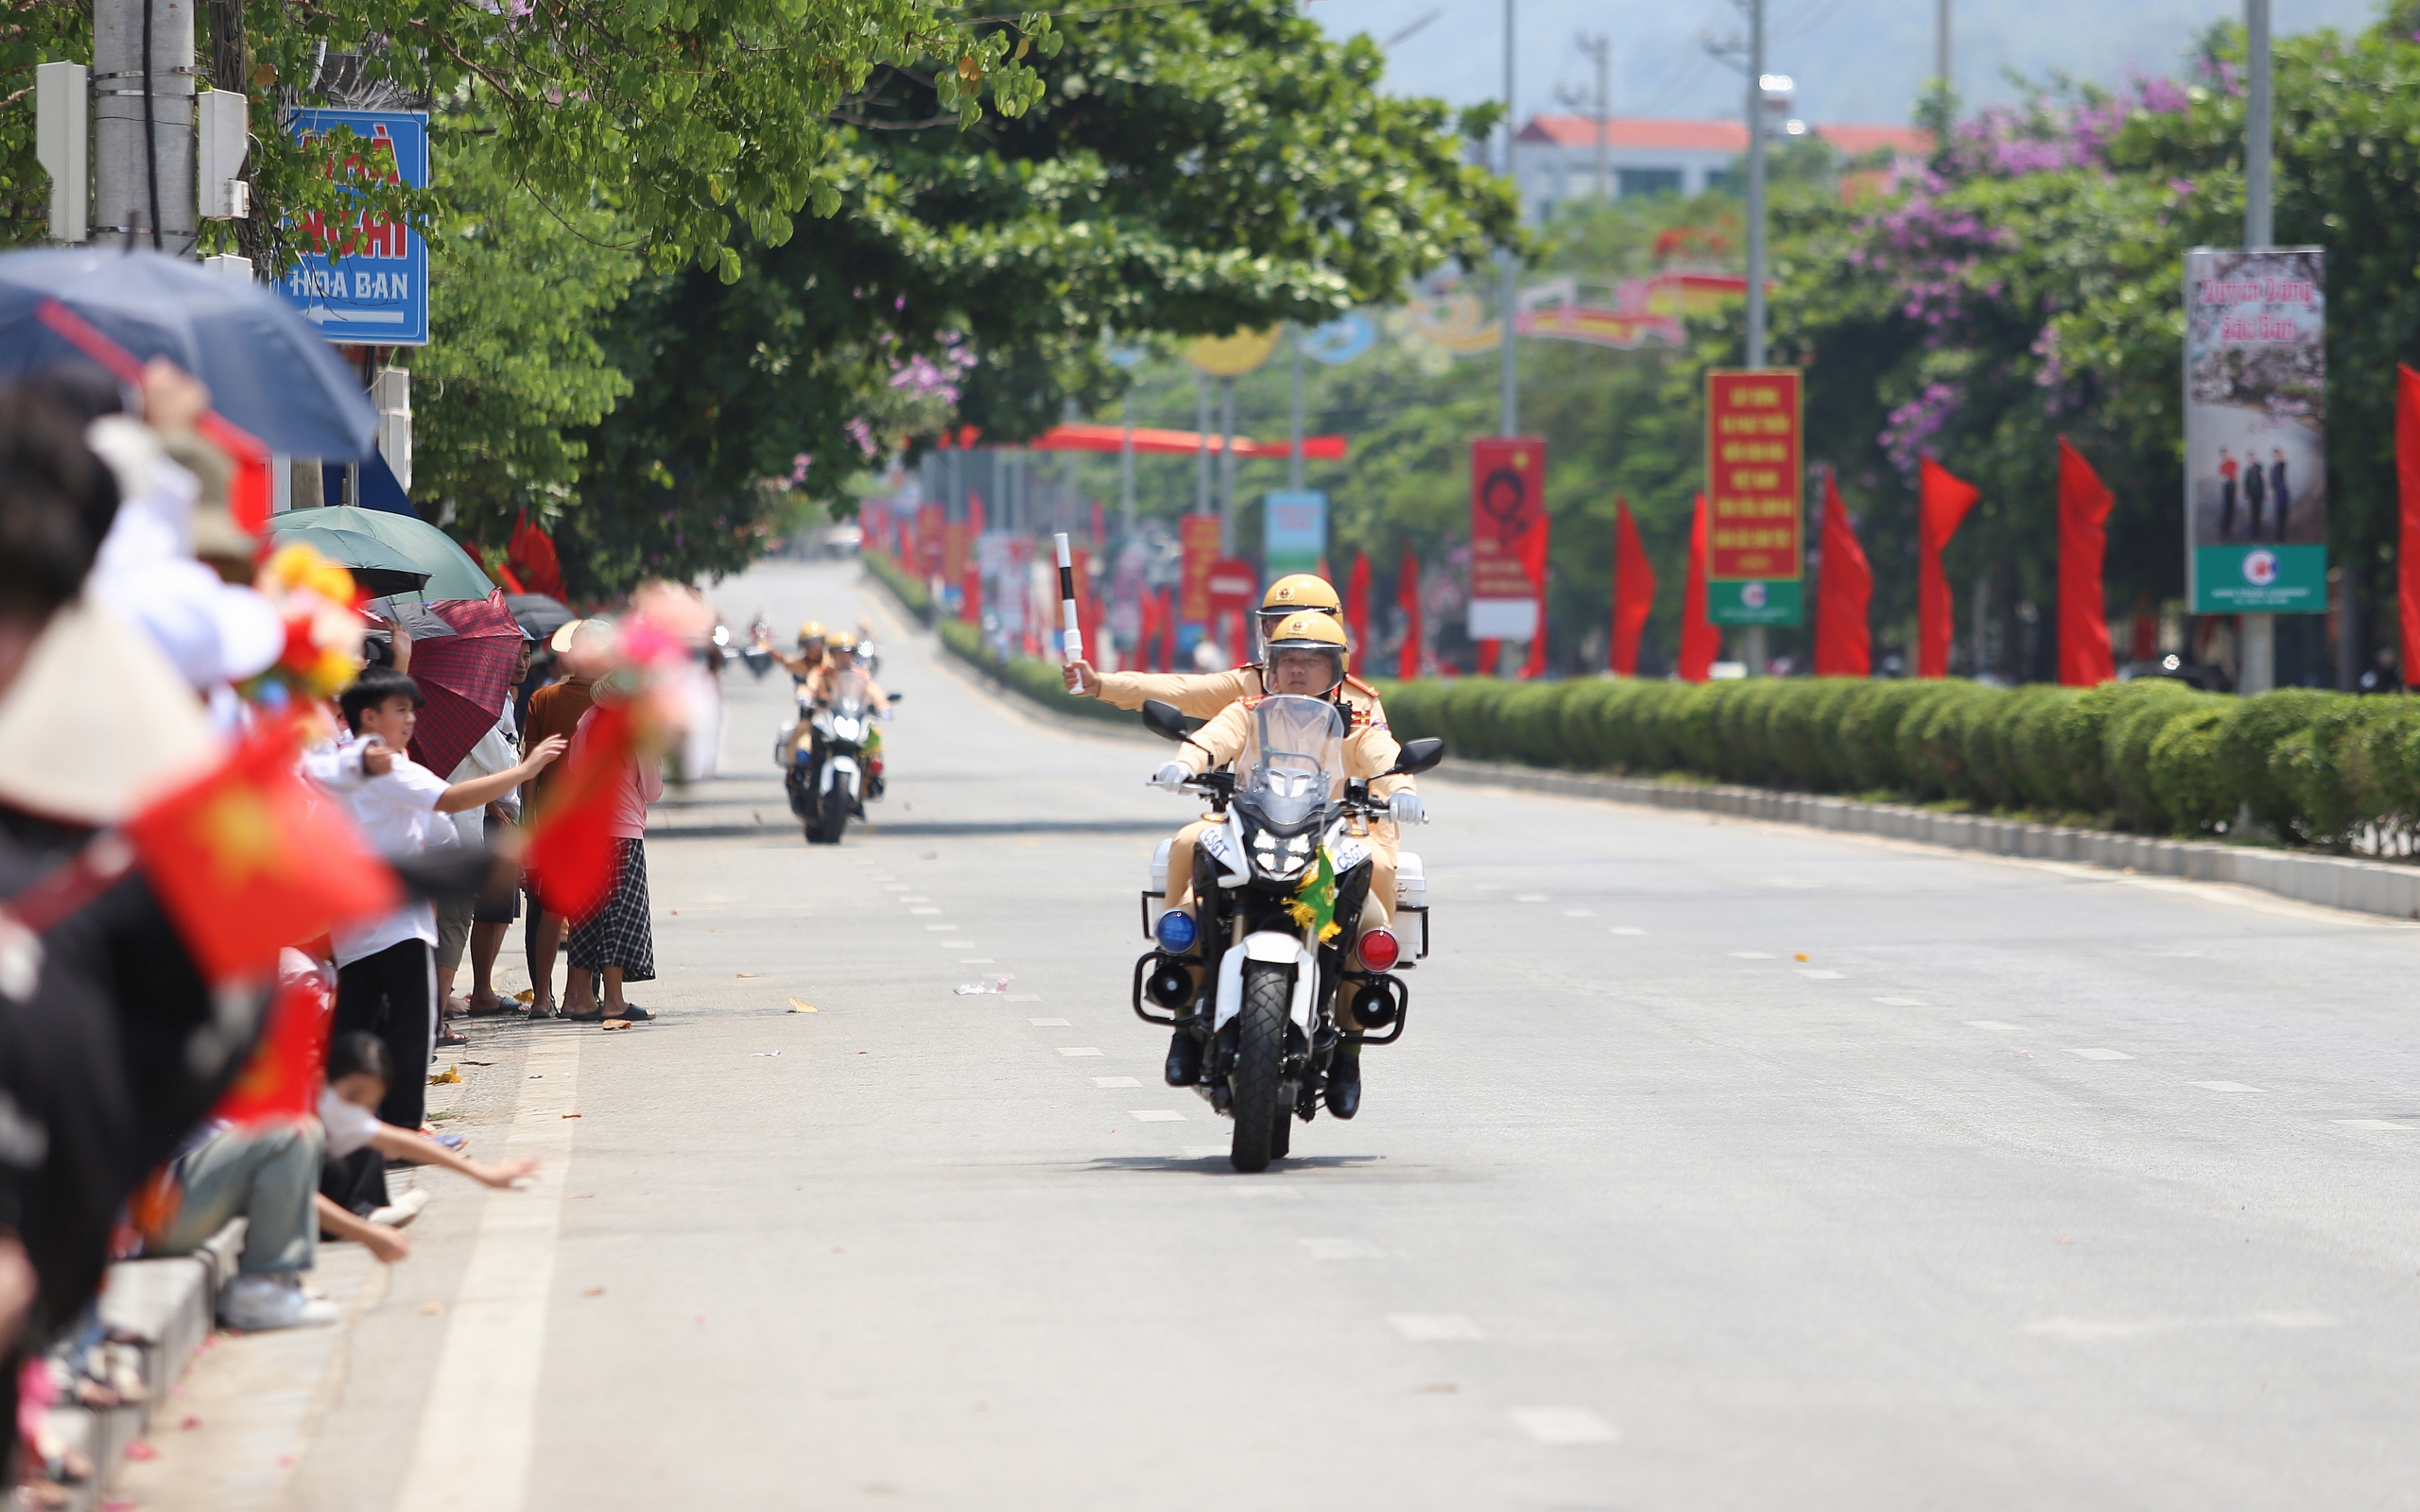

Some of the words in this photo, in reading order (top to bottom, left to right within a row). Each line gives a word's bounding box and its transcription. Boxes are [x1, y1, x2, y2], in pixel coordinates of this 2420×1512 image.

[289, 269, 349, 299] HOA
[354, 271, 408, 301] BAN
[1203, 830, 1230, 858] CSGT
[1337, 844, 1365, 870] CSGT
